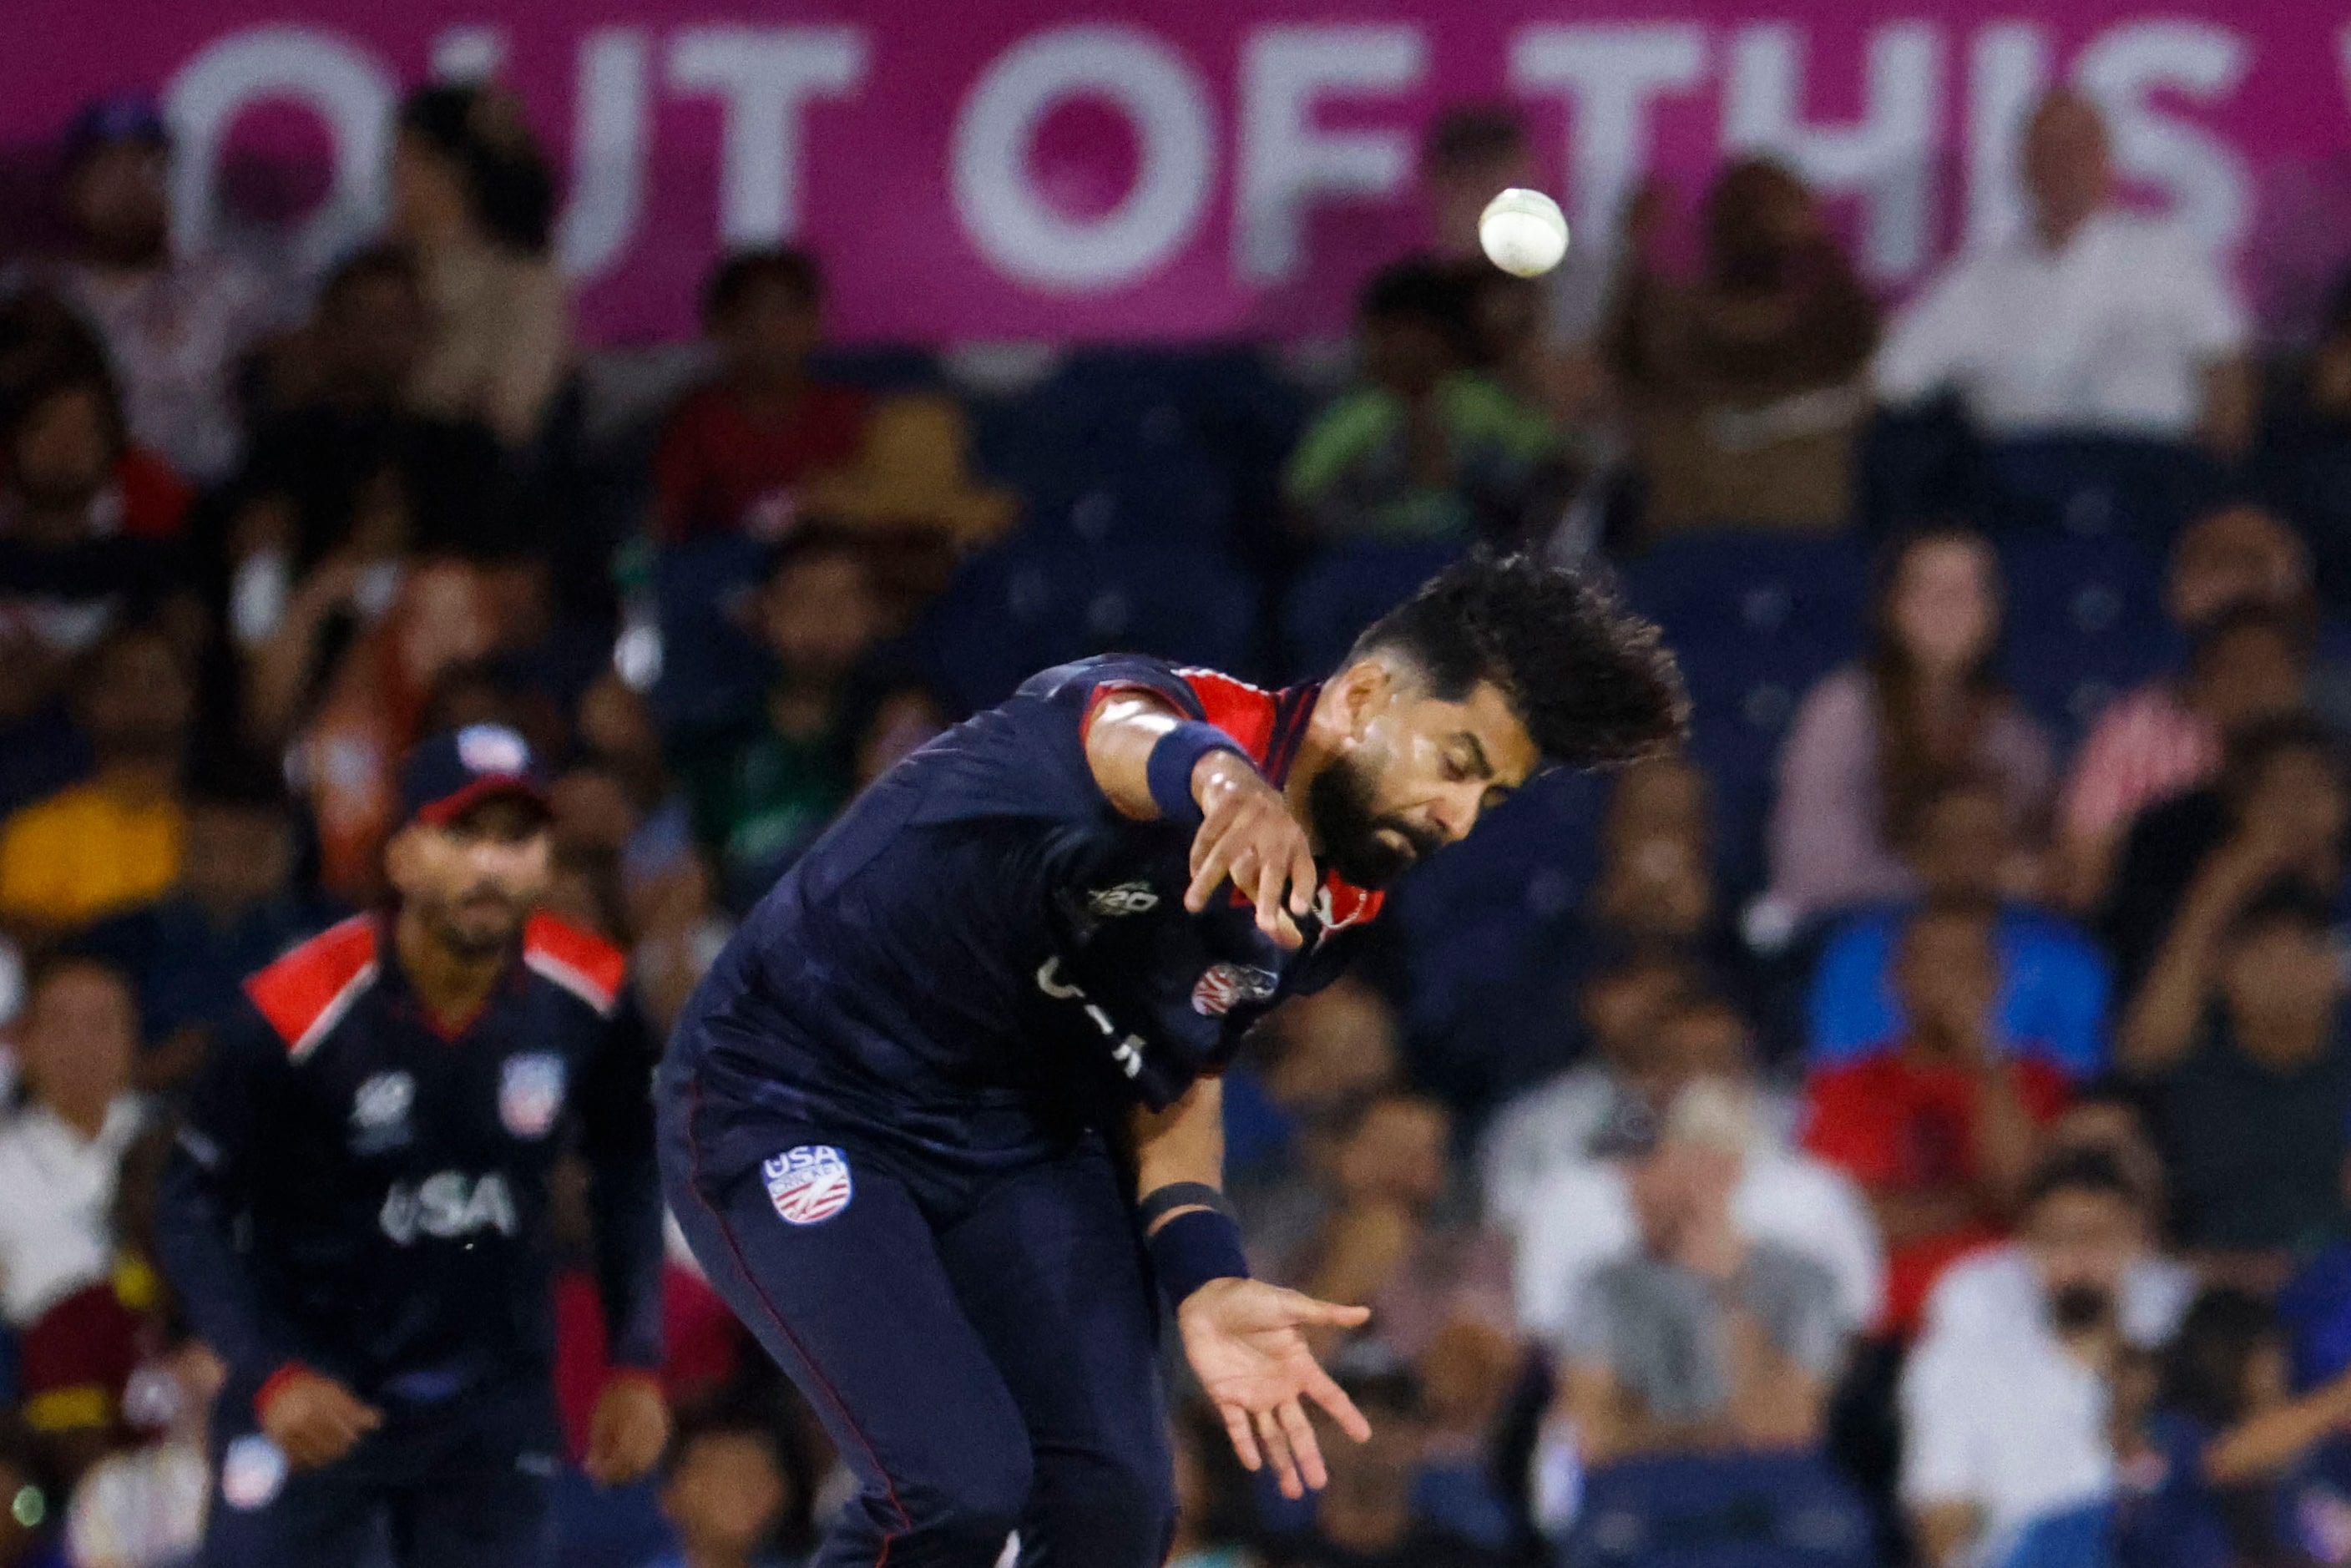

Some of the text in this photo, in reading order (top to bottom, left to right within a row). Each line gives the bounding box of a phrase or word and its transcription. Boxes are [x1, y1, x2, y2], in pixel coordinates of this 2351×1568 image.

[167, 23, 2253, 294] OUT OF THIS
[765, 1145, 840, 1178] USA
[379, 1171, 517, 1246] USA
